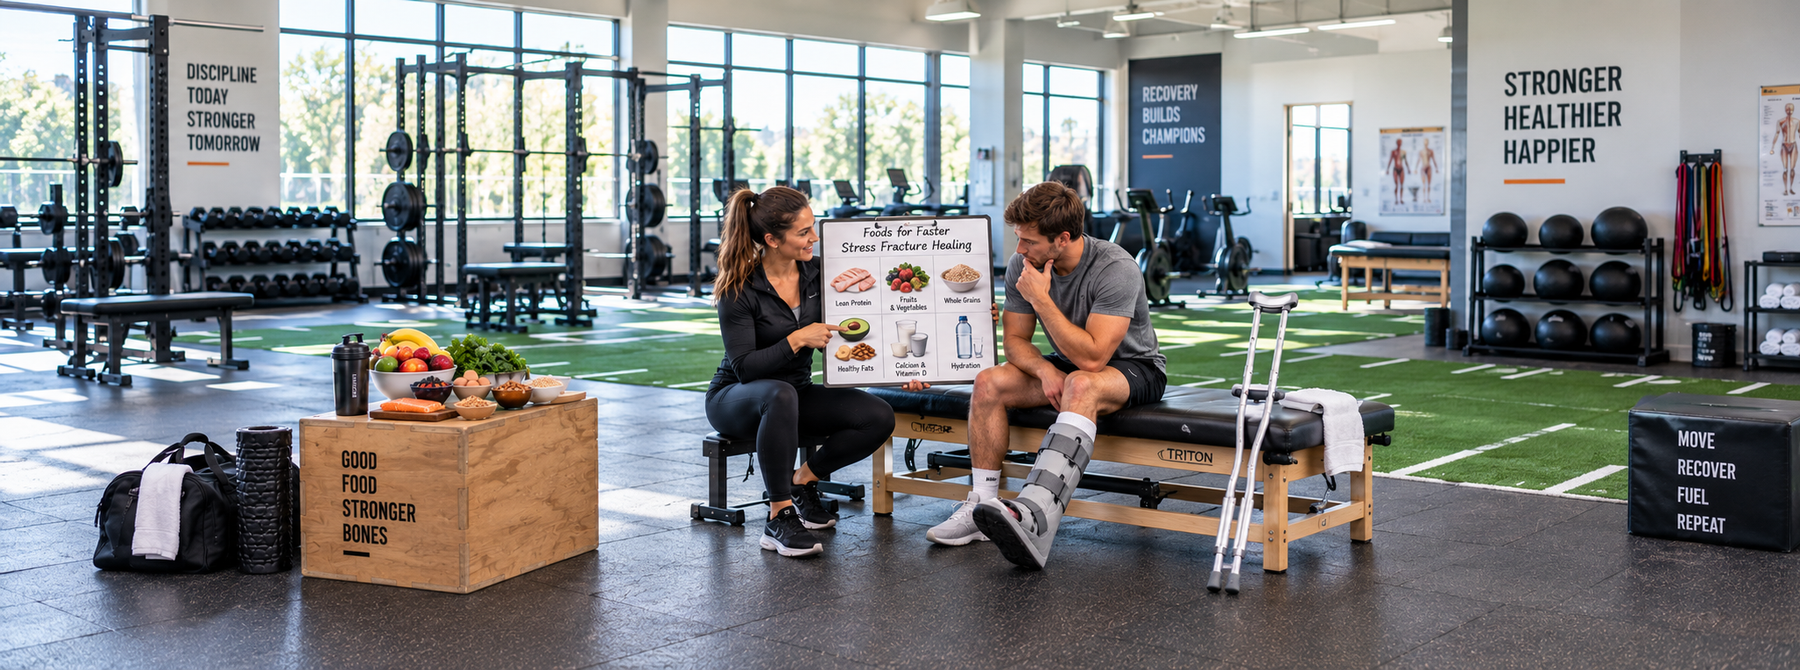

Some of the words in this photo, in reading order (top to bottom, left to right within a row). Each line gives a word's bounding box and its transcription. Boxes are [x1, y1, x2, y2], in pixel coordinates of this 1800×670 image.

[187, 63, 257, 83] DISCIPLINE
[1505, 66, 1621, 96] STRONGER
[187, 87, 228, 105] TODAY
[1143, 84, 1197, 102] RECOVERY
[188, 111, 255, 129] STRONGER
[1143, 106, 1180, 123] BUILDS
[1505, 101, 1621, 130] HEALTHIER
[187, 134, 260, 151] TOMORROW
[1143, 127, 1205, 145] CHAMPIONS
[1505, 138, 1595, 164] HAPPIER
[863, 226, 893, 238] Foods
[897, 225, 912, 237] for
[916, 225, 950, 236] Faster
[842, 242, 875, 253] Stress
[881, 241, 927, 251] Fracture
[931, 239, 972, 253] Healing
[850, 299, 872, 307] Protein
[889, 304, 896, 312] &
[895, 303, 928, 313] Vegetables
[899, 295, 918, 303] Fruits
[962, 296, 982, 304] Grains
[837, 364, 860, 374] Healthy
[860, 364, 875, 372] Fats
[920, 361, 926, 369] &
[921, 369, 928, 377] D
[950, 362, 981, 371] Hydration
[1678, 430, 1715, 450] MOVE
[342, 450, 377, 469] GOOD
[1167, 447, 1213, 463] TRITON
[1678, 459, 1735, 479] RECOVER
[342, 474, 376, 494] FOOD
[1678, 487, 1709, 505] FUEL
[343, 499, 416, 523] STRONGER
[1678, 514, 1725, 533] REPEAT
[343, 524, 387, 545] BONES
